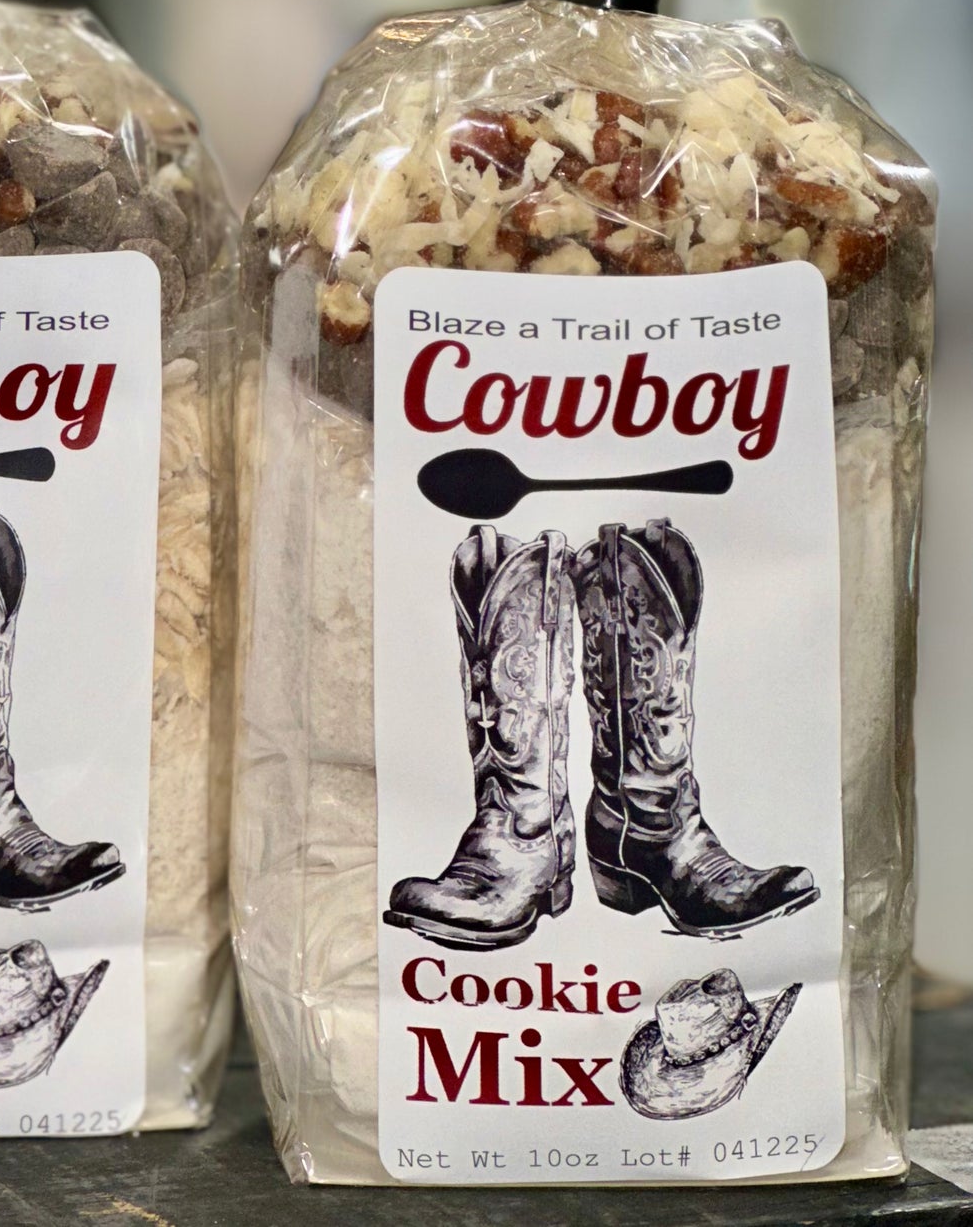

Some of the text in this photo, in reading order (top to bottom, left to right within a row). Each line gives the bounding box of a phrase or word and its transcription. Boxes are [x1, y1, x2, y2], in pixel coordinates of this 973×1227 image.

[15, 310, 110, 332] Taste
[408, 309, 782, 341] Blaze a Trail of Taste
[403, 339, 790, 461] Cowboy
[401, 956, 642, 1015] Cookie
[405, 1026, 615, 1107] Mix
[19, 1110, 122, 1134] 041225
[397, 1133, 819, 1169] Net Wt 10oz Lot# 041225
